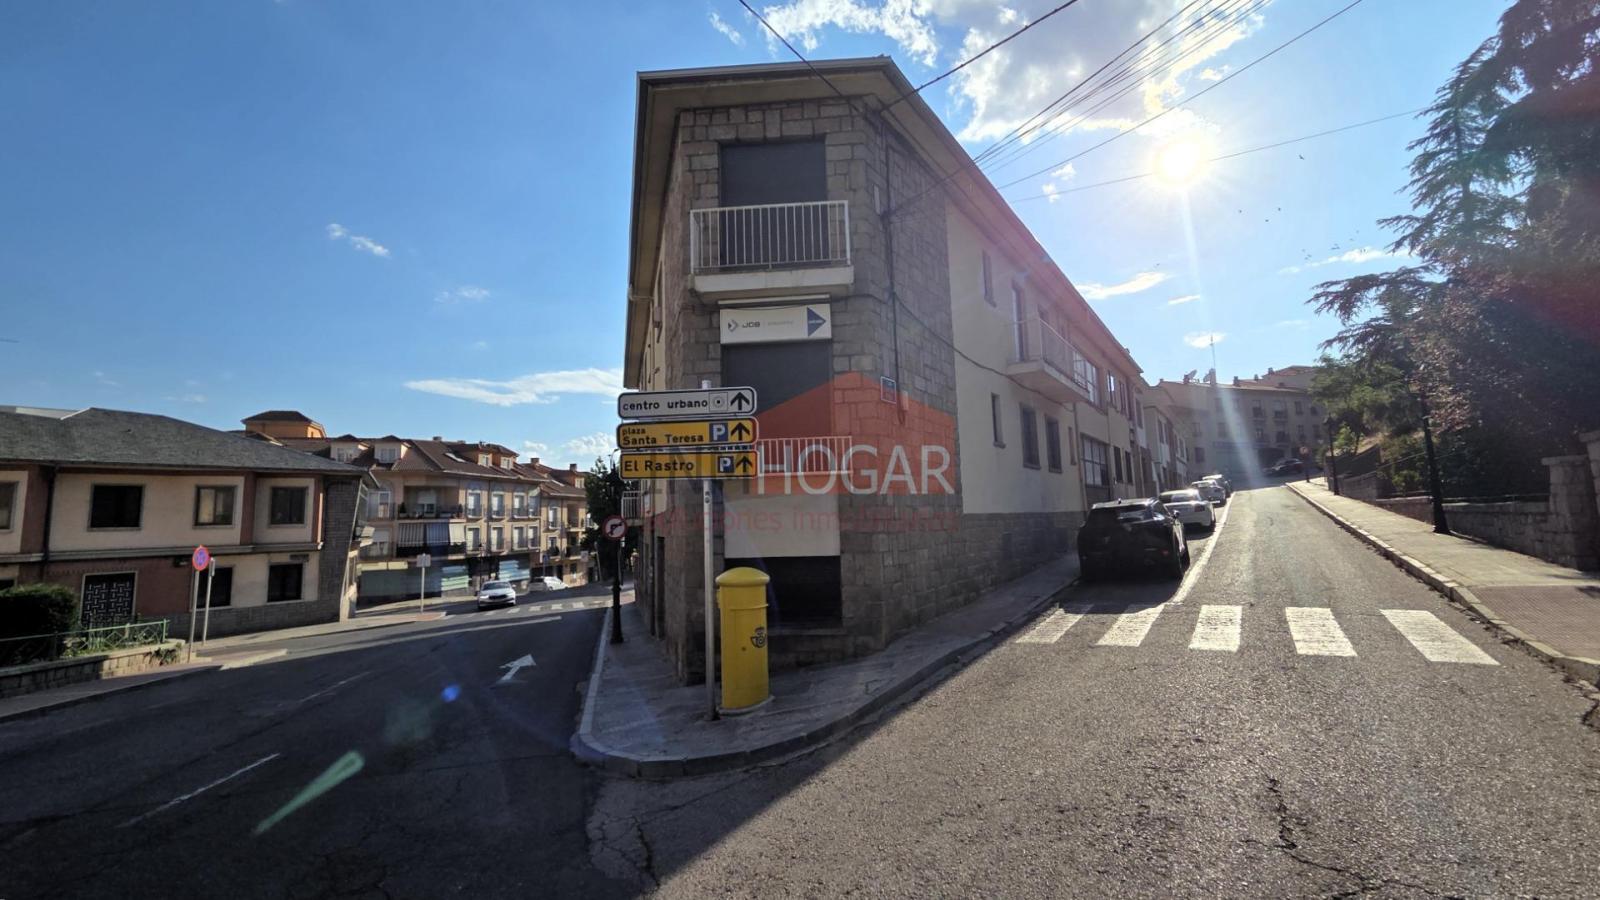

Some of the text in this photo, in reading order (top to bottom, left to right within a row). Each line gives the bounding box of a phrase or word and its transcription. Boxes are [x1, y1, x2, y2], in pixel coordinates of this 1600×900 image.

[623, 400, 708, 411] centro urbano
[622, 427, 646, 436] plaza
[712, 424, 726, 441] P
[622, 434, 704, 446] Santa Teresa
[624, 460, 694, 472] El Rastro
[719, 457, 732, 472] P
